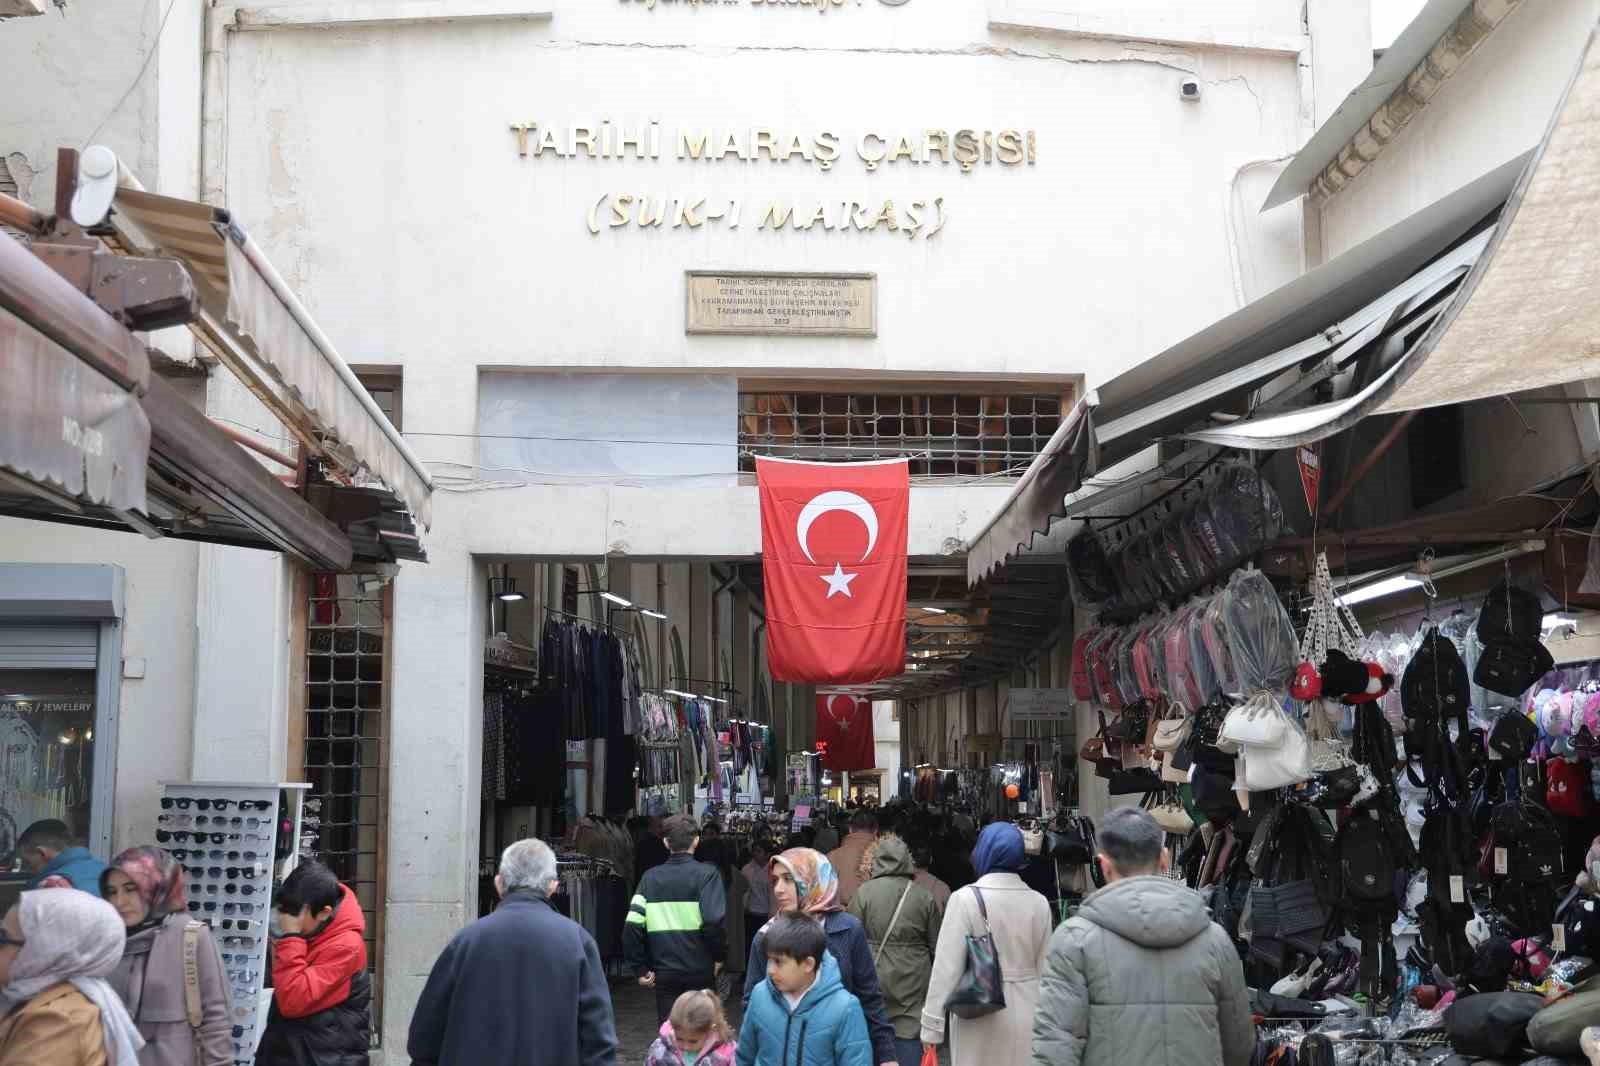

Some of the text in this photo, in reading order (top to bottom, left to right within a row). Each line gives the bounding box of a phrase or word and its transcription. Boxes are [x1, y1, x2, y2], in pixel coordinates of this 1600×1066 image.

[509, 119, 1037, 173] TARİHİ MARAŞ ÇARŞISI
[757, 196, 947, 241] MARAŞ)
